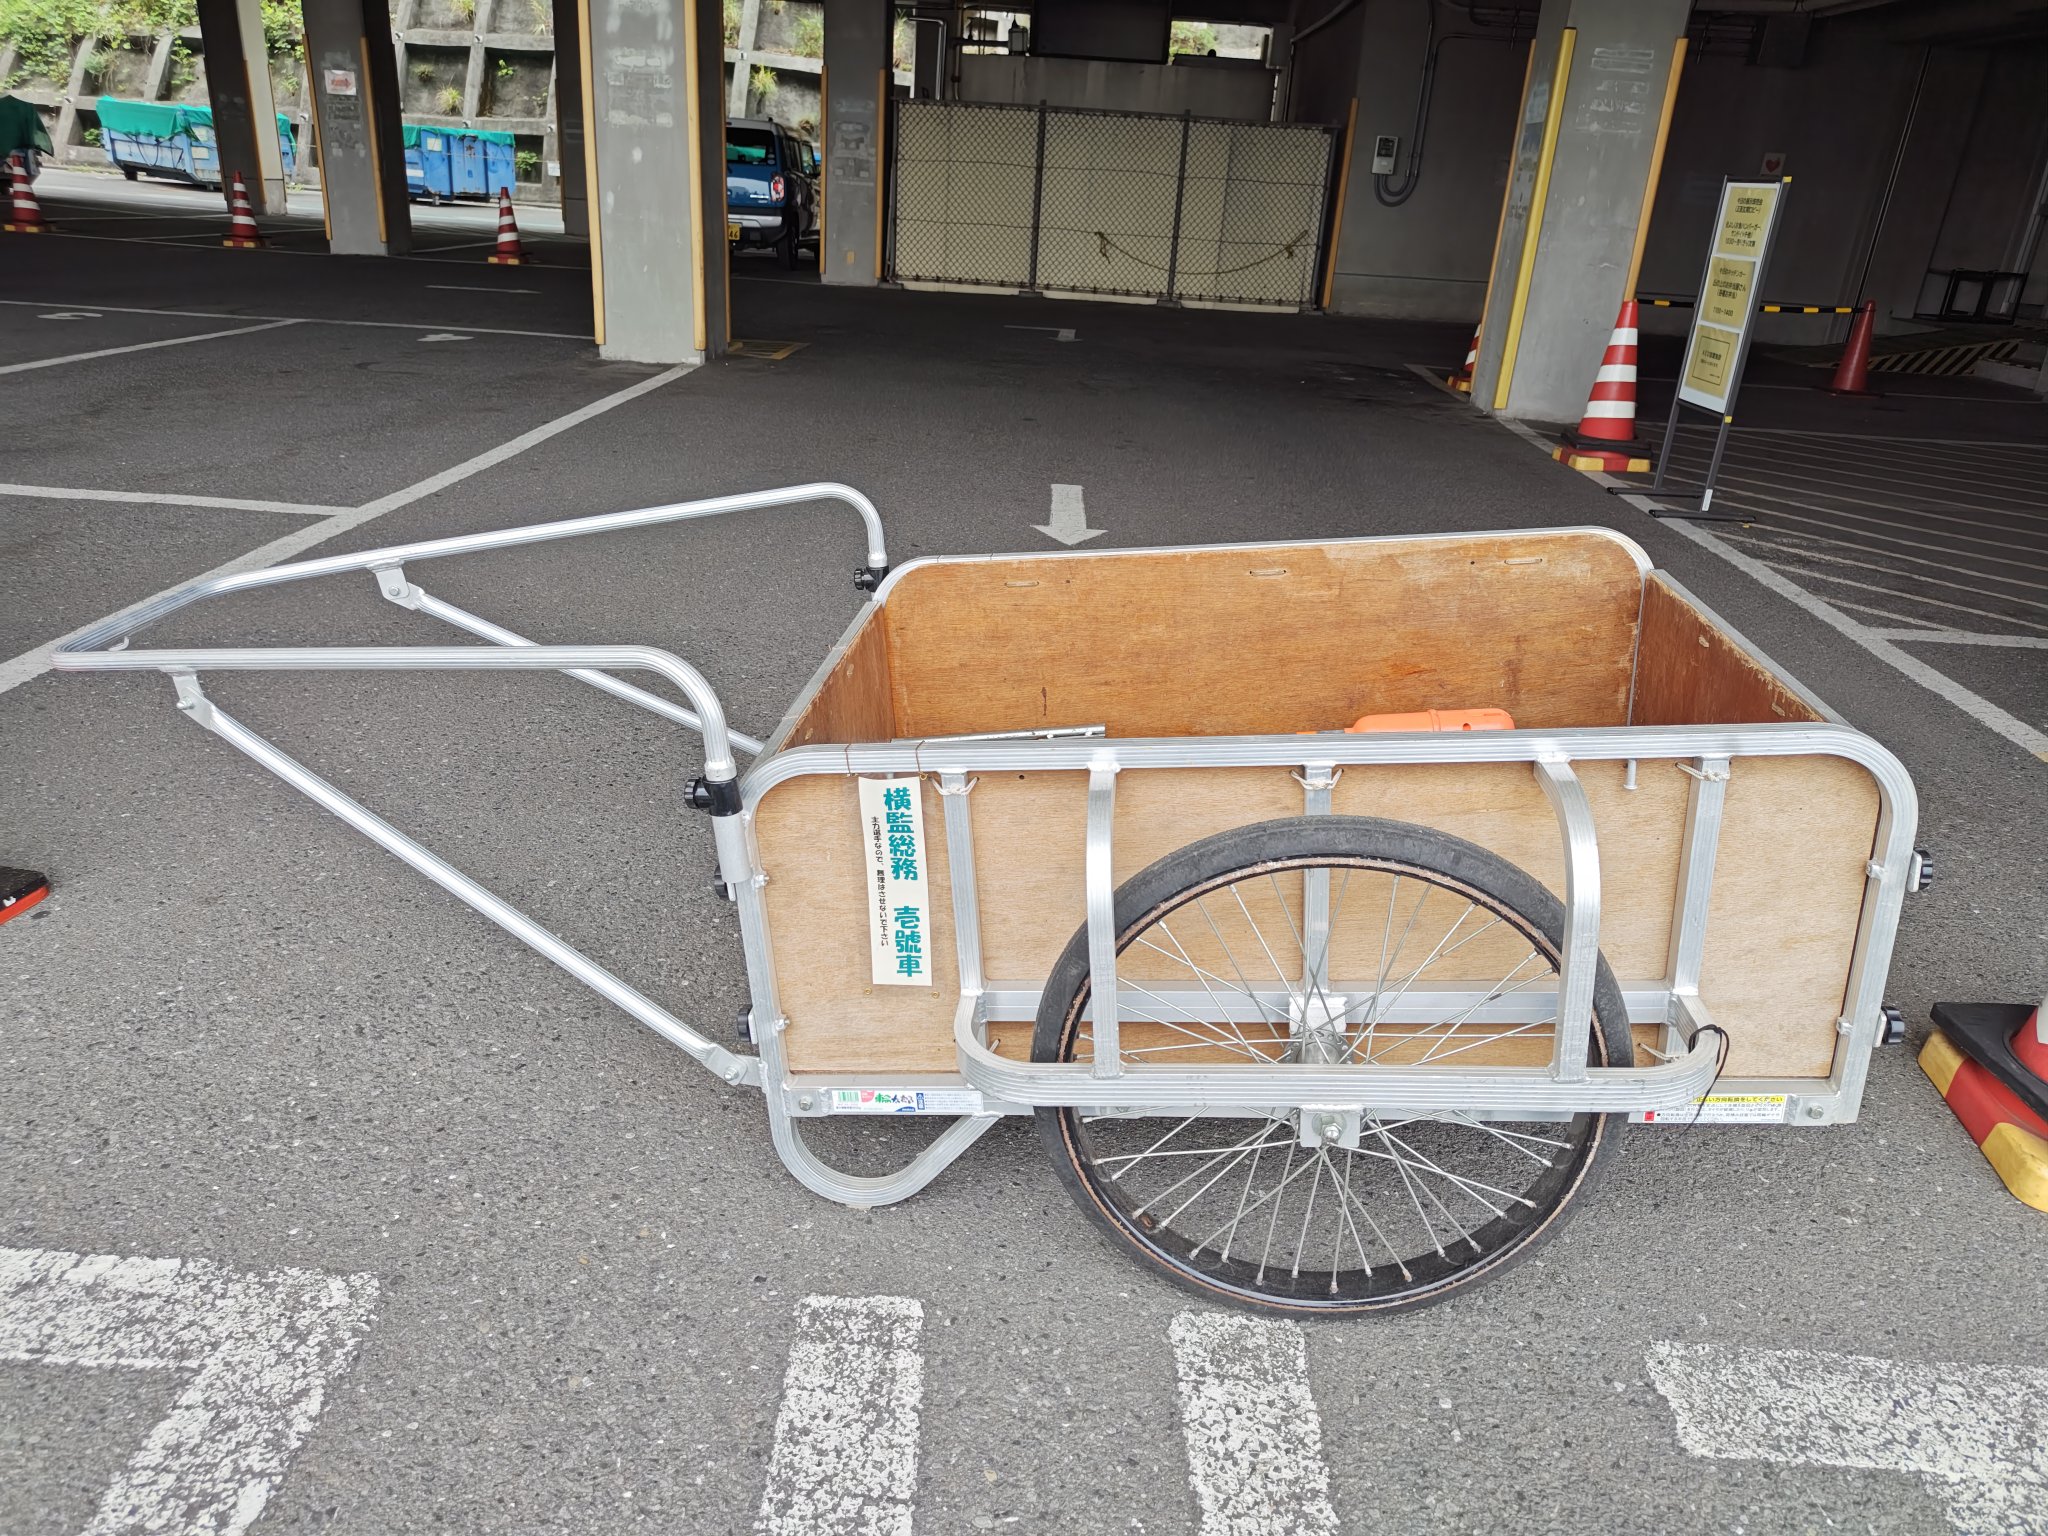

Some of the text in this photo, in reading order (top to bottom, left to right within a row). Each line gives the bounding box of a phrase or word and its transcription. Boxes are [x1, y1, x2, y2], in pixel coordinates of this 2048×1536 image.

[871, 816, 889, 946] 主力選手なので、無理はさせないで下さい
[883, 786, 923, 978] 横監総務 壱號車
